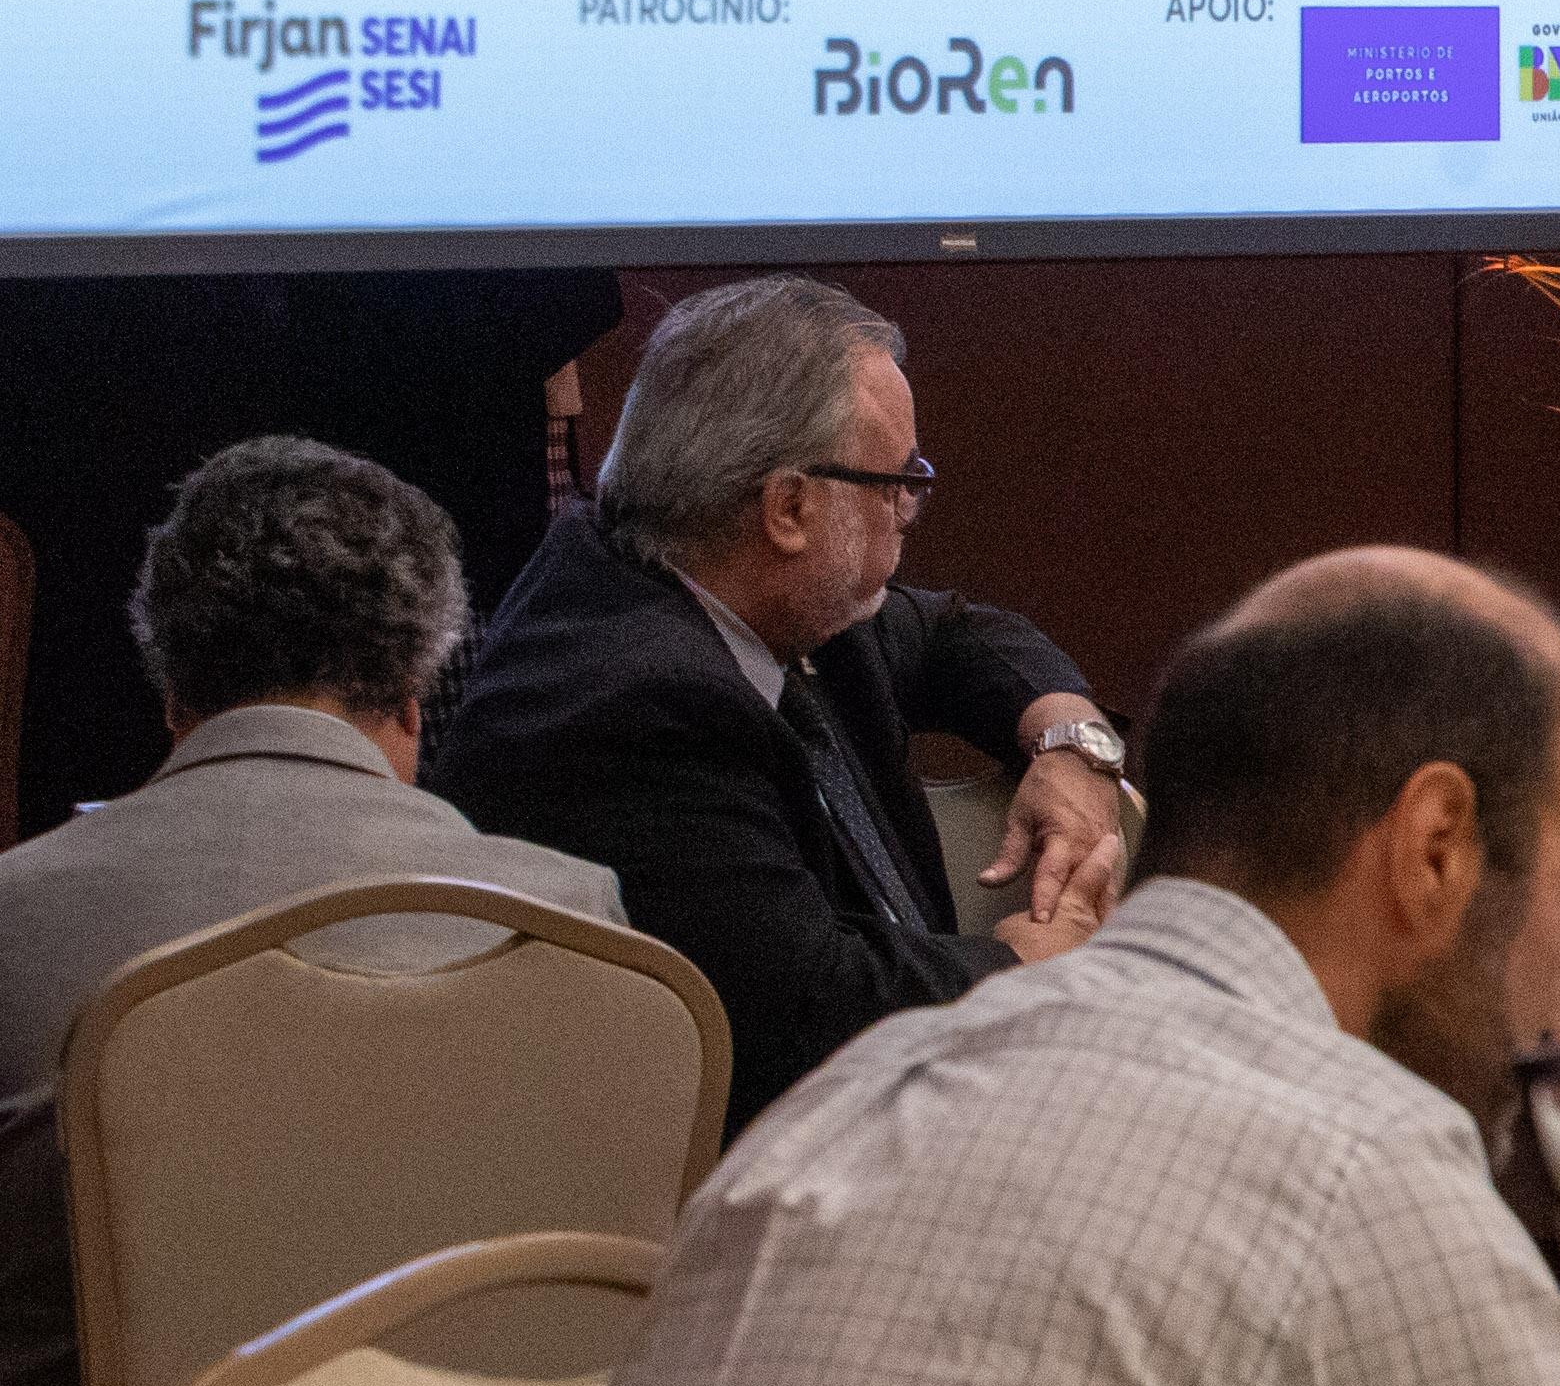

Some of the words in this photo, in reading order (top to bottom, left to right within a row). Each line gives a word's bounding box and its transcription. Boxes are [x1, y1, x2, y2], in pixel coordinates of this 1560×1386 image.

[188, 0, 350, 73] Firjan
[359, 17, 477, 57] SENAI
[1437, 46, 1454, 60] DE
[1366, 68, 1422, 81] PORTOS
[1428, 68, 1436, 80] E
[359, 69, 441, 110] SESI
[1353, 90, 1449, 103] AEROPORTOS
